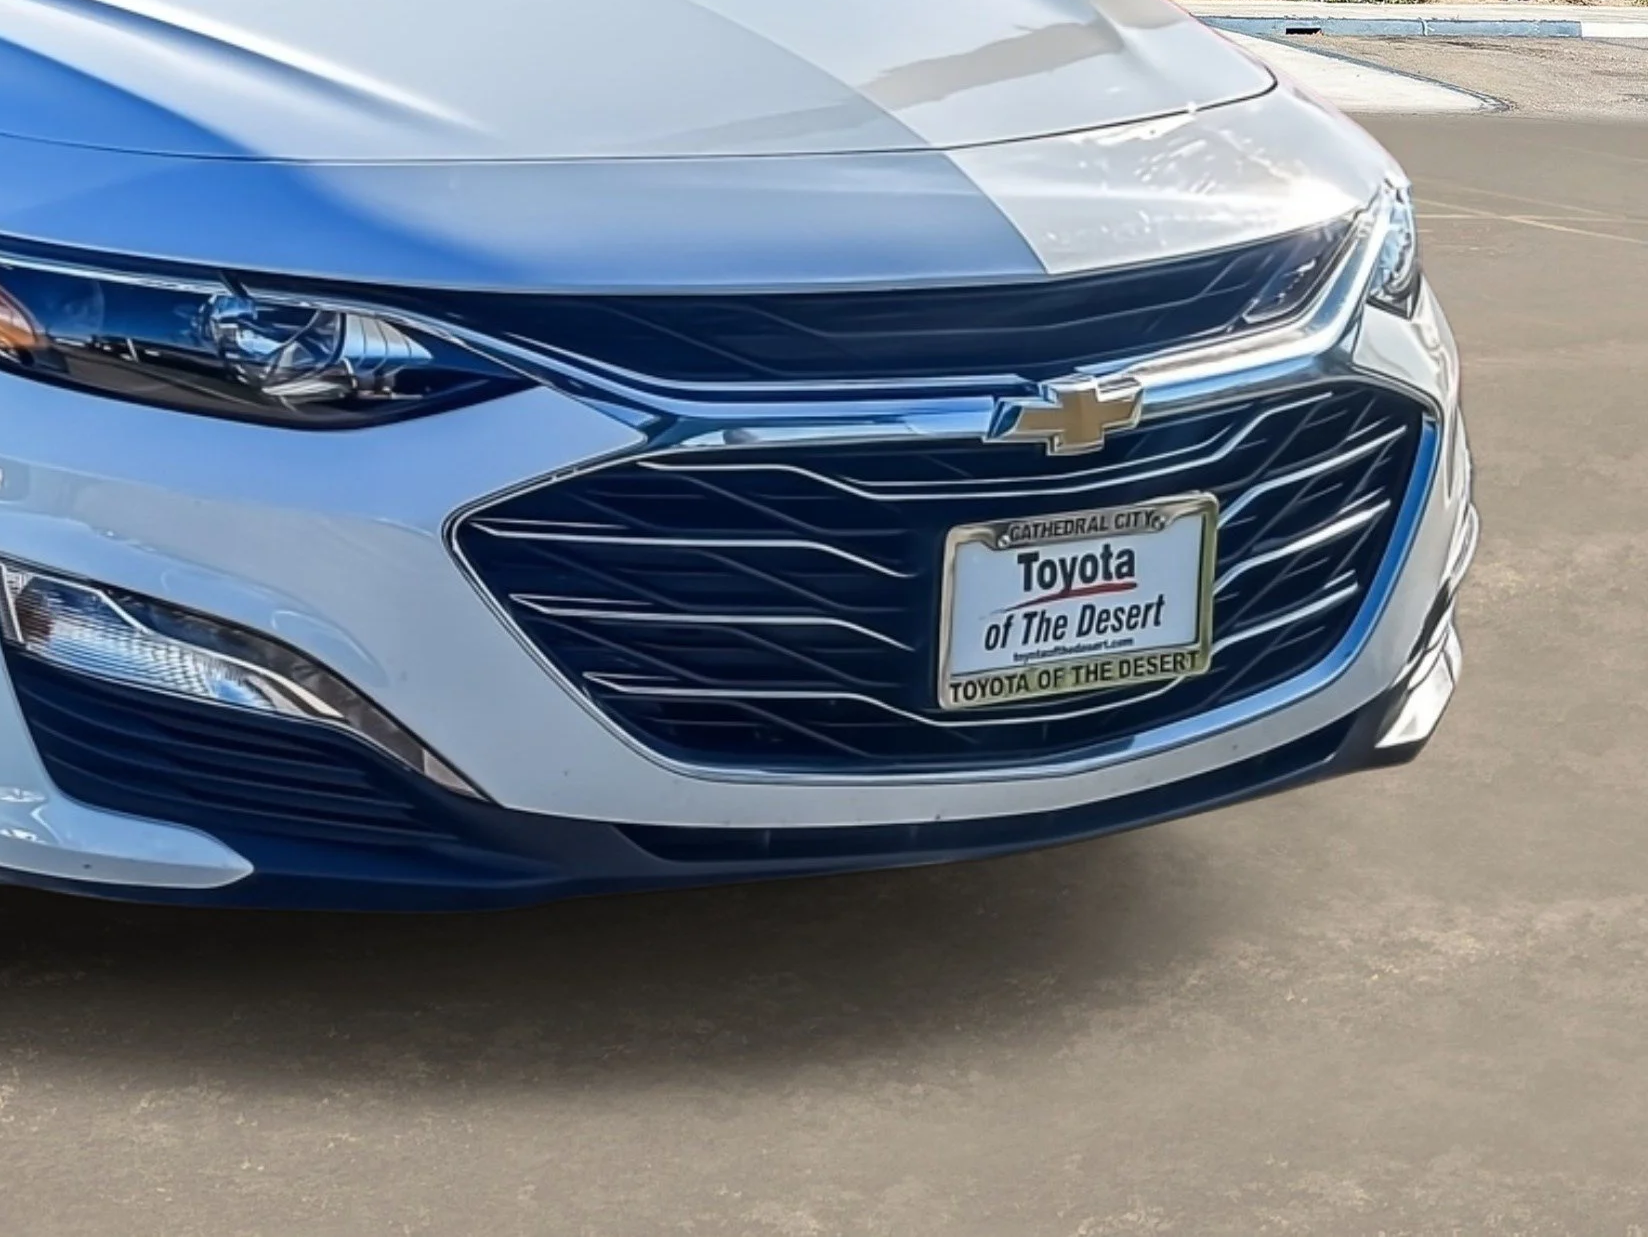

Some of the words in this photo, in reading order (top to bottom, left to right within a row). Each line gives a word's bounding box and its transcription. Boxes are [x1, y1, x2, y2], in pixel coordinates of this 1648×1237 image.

[1009, 514, 1110, 541] CATHEDRAL
[1113, 509, 1155, 531] CITY
[1017, 543, 1136, 597] Toyota
[984, 613, 1015, 651] of
[1020, 609, 1068, 645] The
[1076, 593, 1166, 638] Desert
[949, 673, 1030, 703] TOYOTA
[1037, 669, 1068, 690] OF
[1071, 661, 1114, 685] THE
[1118, 649, 1201, 679] DESERT
